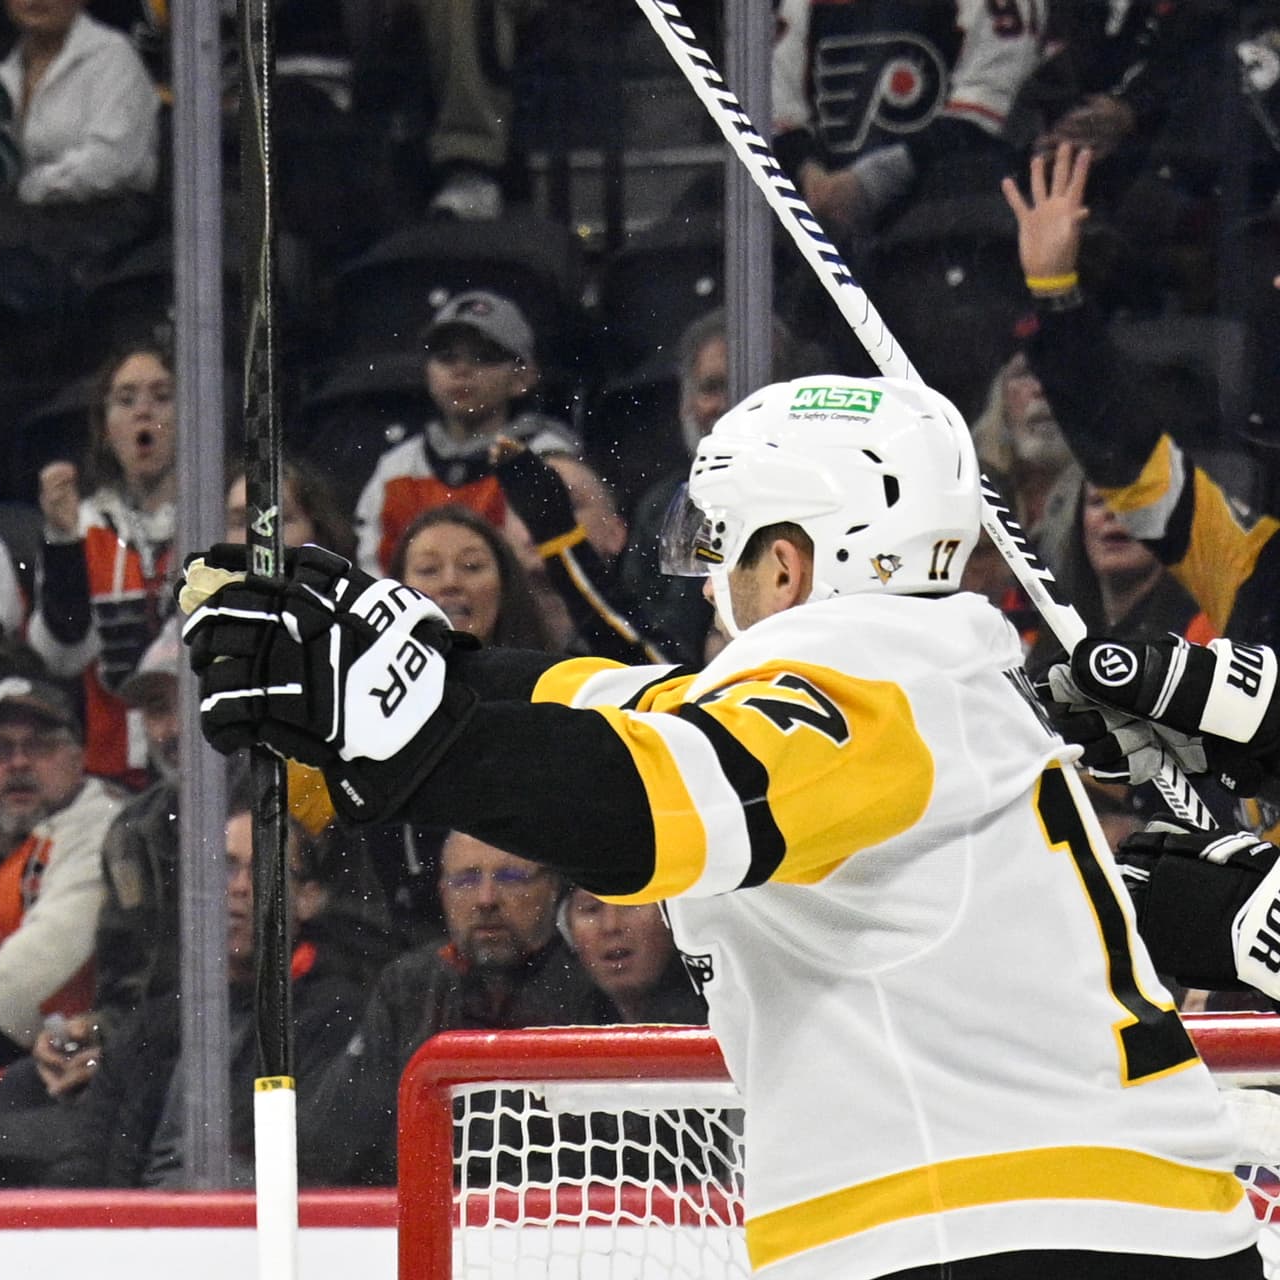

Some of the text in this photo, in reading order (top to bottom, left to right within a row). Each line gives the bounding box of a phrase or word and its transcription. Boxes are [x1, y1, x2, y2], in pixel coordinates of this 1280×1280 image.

[792, 388, 874, 412] MSA
[928, 540, 962, 581] 17
[1032, 760, 1202, 1088] 1
